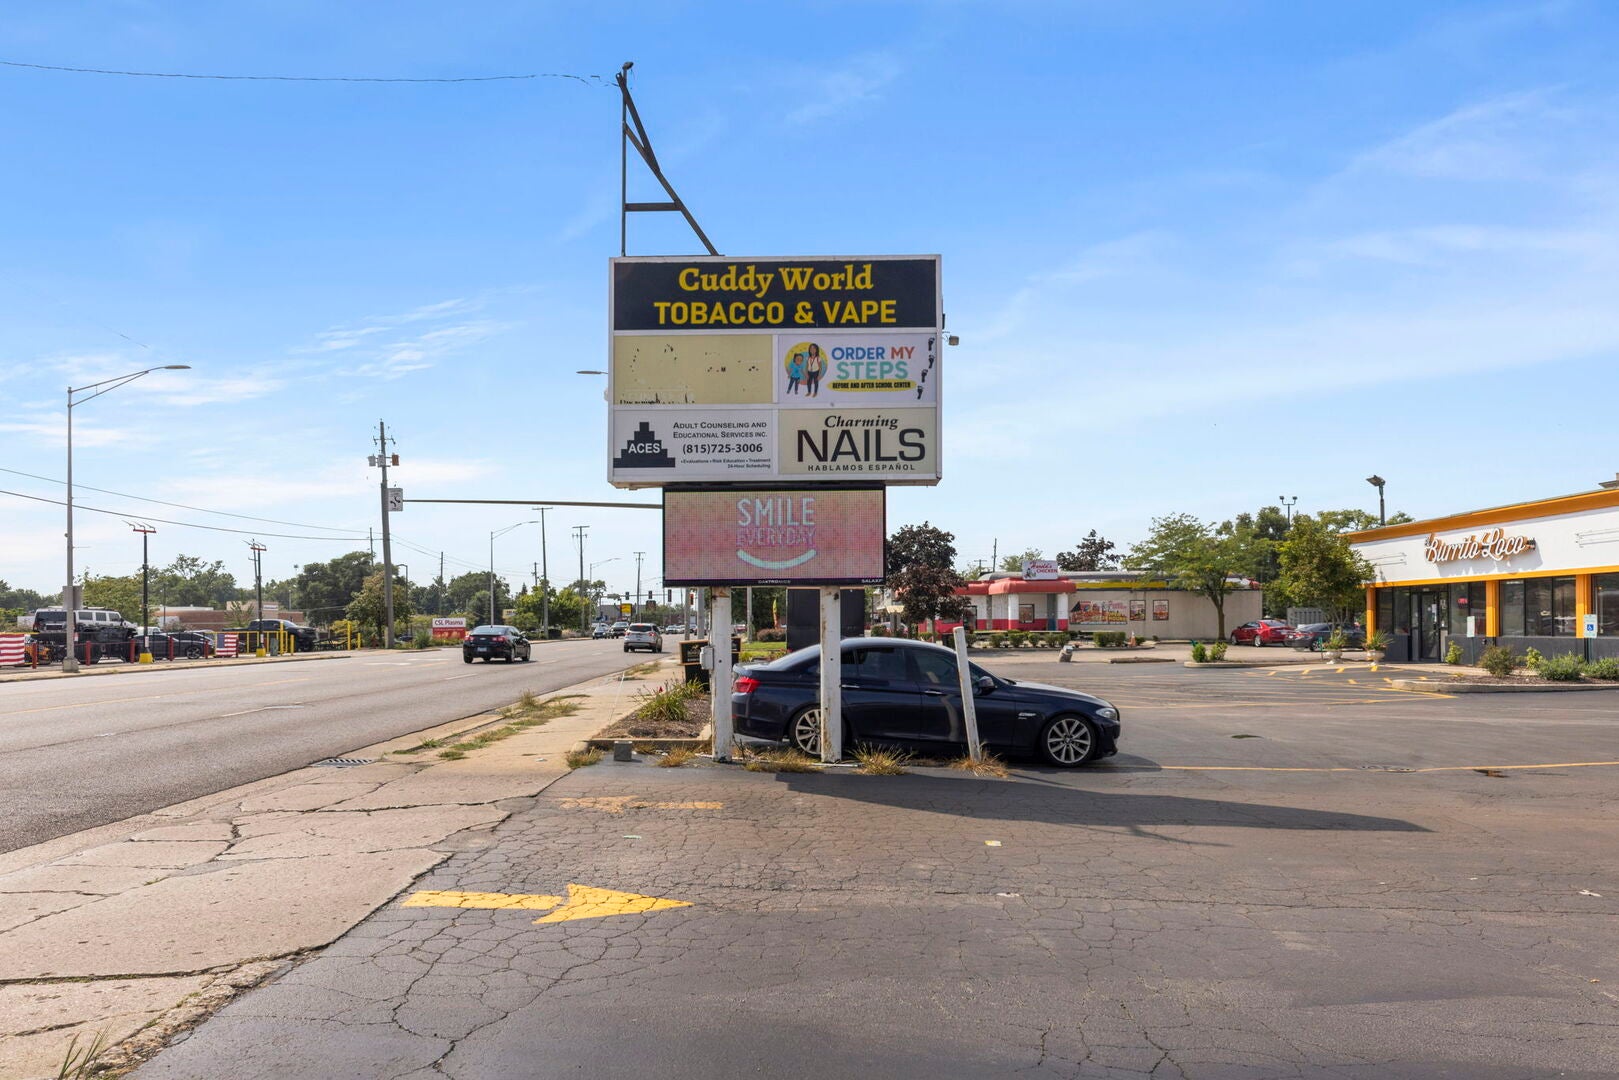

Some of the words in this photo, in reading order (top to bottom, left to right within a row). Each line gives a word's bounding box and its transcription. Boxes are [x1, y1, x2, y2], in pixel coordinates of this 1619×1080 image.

[678, 264, 774, 298] Cuddy
[778, 263, 874, 291] World
[653, 301, 785, 325] TOBACCO
[794, 301, 815, 324] &
[822, 300, 897, 324] VAPE
[831, 346, 886, 360] ORDER
[890, 346, 916, 360] MY
[836, 361, 909, 380] STEPS
[824, 415, 899, 430] Charming
[628, 442, 661, 454] ACES
[682, 443, 763, 455] (815)725-3006
[797, 428, 926, 463] NAILS
[807, 464, 864, 472] HABLAMOS
[868, 462, 916, 471] ESPAÑOL
[736, 496, 816, 527] SMILE
[736, 527, 817, 546] EVERYDAY
[1424, 534, 1481, 563] Burrito
[1481, 528, 1526, 561] Loco
